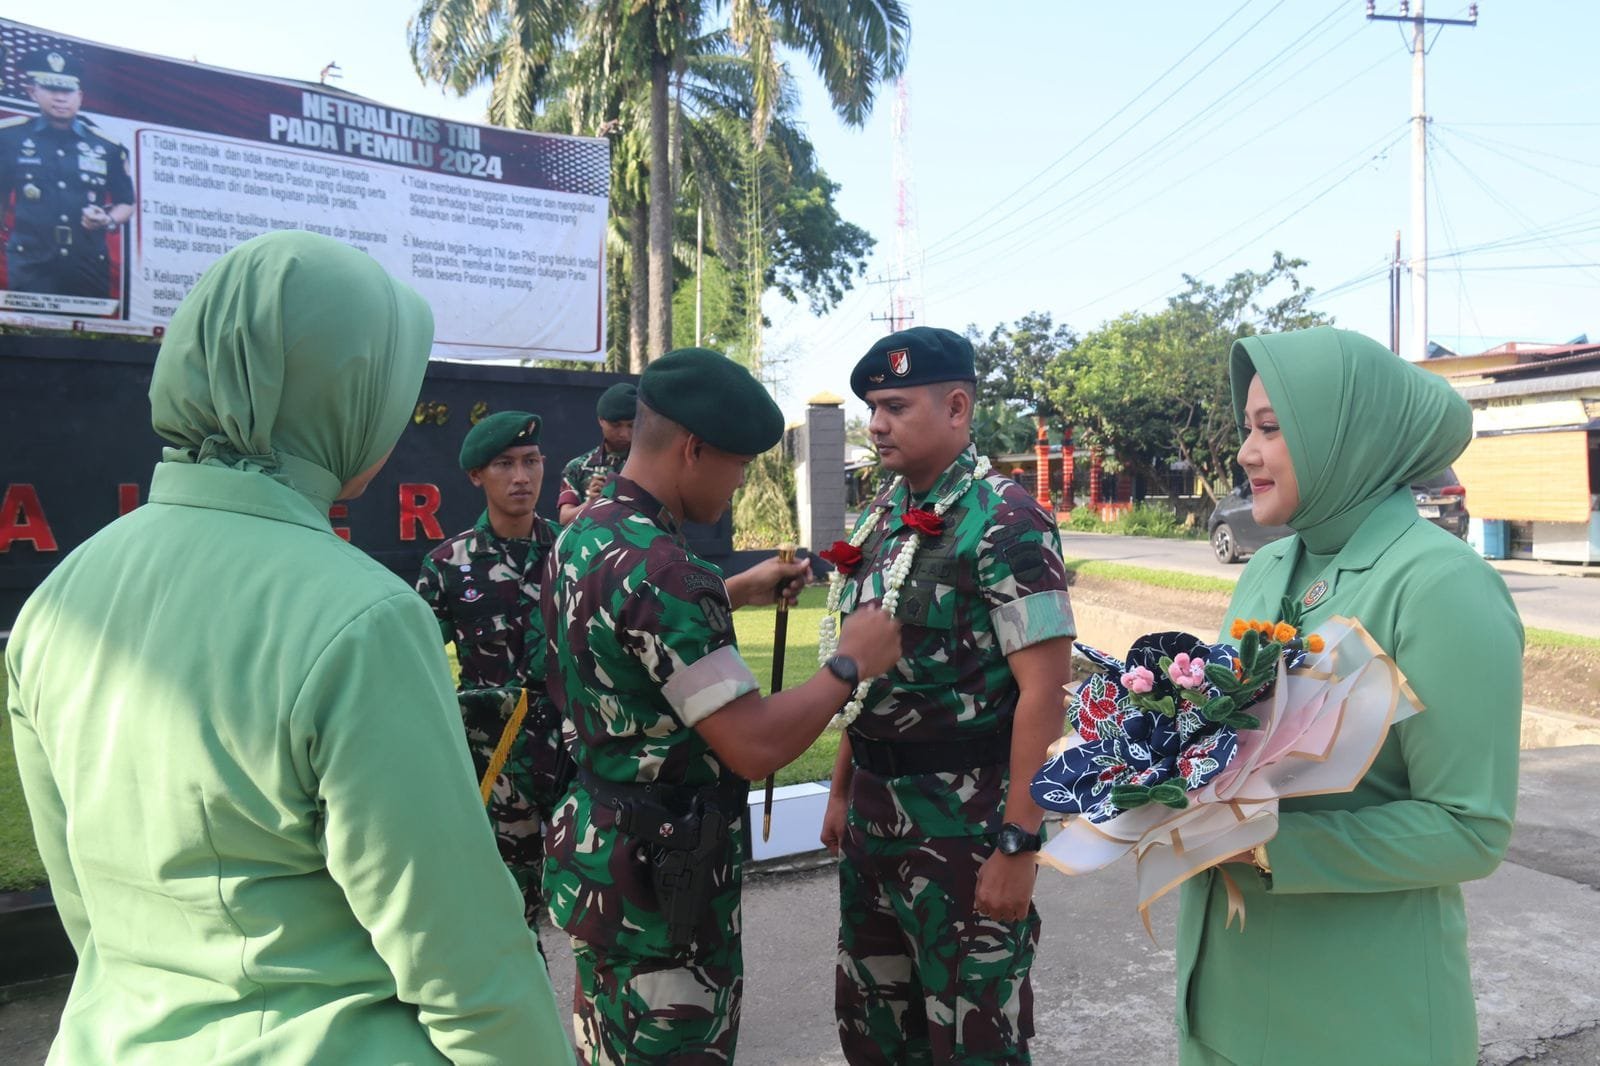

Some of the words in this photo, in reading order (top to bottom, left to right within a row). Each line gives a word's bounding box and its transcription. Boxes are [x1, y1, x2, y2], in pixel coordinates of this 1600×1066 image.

[302, 91, 440, 144] NETRALITAS
[444, 122, 480, 151] TNI
[153, 135, 177, 151] Tidak
[181, 142, 219, 157] memihak
[225, 148, 241, 160] dan
[243, 152, 262, 164] tidak
[265, 156, 300, 169] memberi
[302, 161, 340, 179] dukungan
[342, 166, 370, 182] kepada
[269, 113, 339, 151] PADA
[344, 128, 434, 167] PEMILU
[439, 147, 503, 180] 2024
[153, 151, 179, 168] Partai
[182, 155, 209, 171] Politik
[212, 163, 251, 178] manapun
[253, 167, 284, 183] beserta
[286, 172, 314, 188] Paslon
[315, 179, 334, 193] yang
[336, 181, 366, 198] diusung
[367, 187, 386, 199] serta
[153, 170, 175, 184] tidak
[178, 174, 226, 190] melibatkan
[228, 180, 241, 192] diri
[243, 183, 269, 197] dalam
[271, 186, 305, 202] kegiatan
[306, 192, 329, 205] politik
[331, 196, 359, 210] praktis.
[408, 175, 428, 189] Tidak
[430, 182, 472, 197] memberikan
[512, 193, 542, 207] komentar
[544, 198, 556, 208] dan
[153, 200, 177, 216] Tidak
[181, 207, 233, 223] memberikan
[236, 211, 268, 228] fasilitas
[270, 218, 298, 230] tempat
[305, 223, 332, 236] sarana
[333, 225, 347, 238] dan
[349, 229, 388, 243] prasarana
[409, 192, 435, 206] apapun
[437, 196, 467, 211] terhadap
[468, 201, 485, 212] hasil
[487, 205, 504, 216] quick
[506, 207, 525, 218] count
[526, 209, 559, 223] sementara
[561, 215, 577, 227] yang
[409, 205, 450, 221] dikeluarkan
[451, 212, 466, 223] oleh
[467, 213, 499, 230] Lembaga
[500, 218, 526, 234] Survey.
[153, 220, 174, 232] milik
[177, 220, 193, 234] TNI
[196, 225, 227, 240] kepada
[153, 236, 189, 253] sebagai
[192, 241, 222, 254] sarana
[412, 237, 445, 252] Menindak
[447, 243, 467, 256] tegas
[468, 244, 493, 259] Prajurit
[493, 246, 506, 258] TNI
[508, 250, 520, 260] dan
[521, 250, 537, 263] PNS
[538, 255, 554, 267] yang
[412, 252, 433, 265] politik
[462, 259, 492, 271] memihak
[494, 262, 506, 272] dan
[507, 264, 536, 276] memberi
[538, 266, 567, 281] dukungan
[568, 268, 587, 280] Partai
[153, 268, 195, 288] Keluarga
[153, 286, 184, 301] selaku
[412, 265, 434, 279] Politik
[435, 269, 462, 282] beserta
[464, 271, 487, 285] Paslon
[489, 276, 505, 289] yang
[507, 277, 535, 292] diusung.
